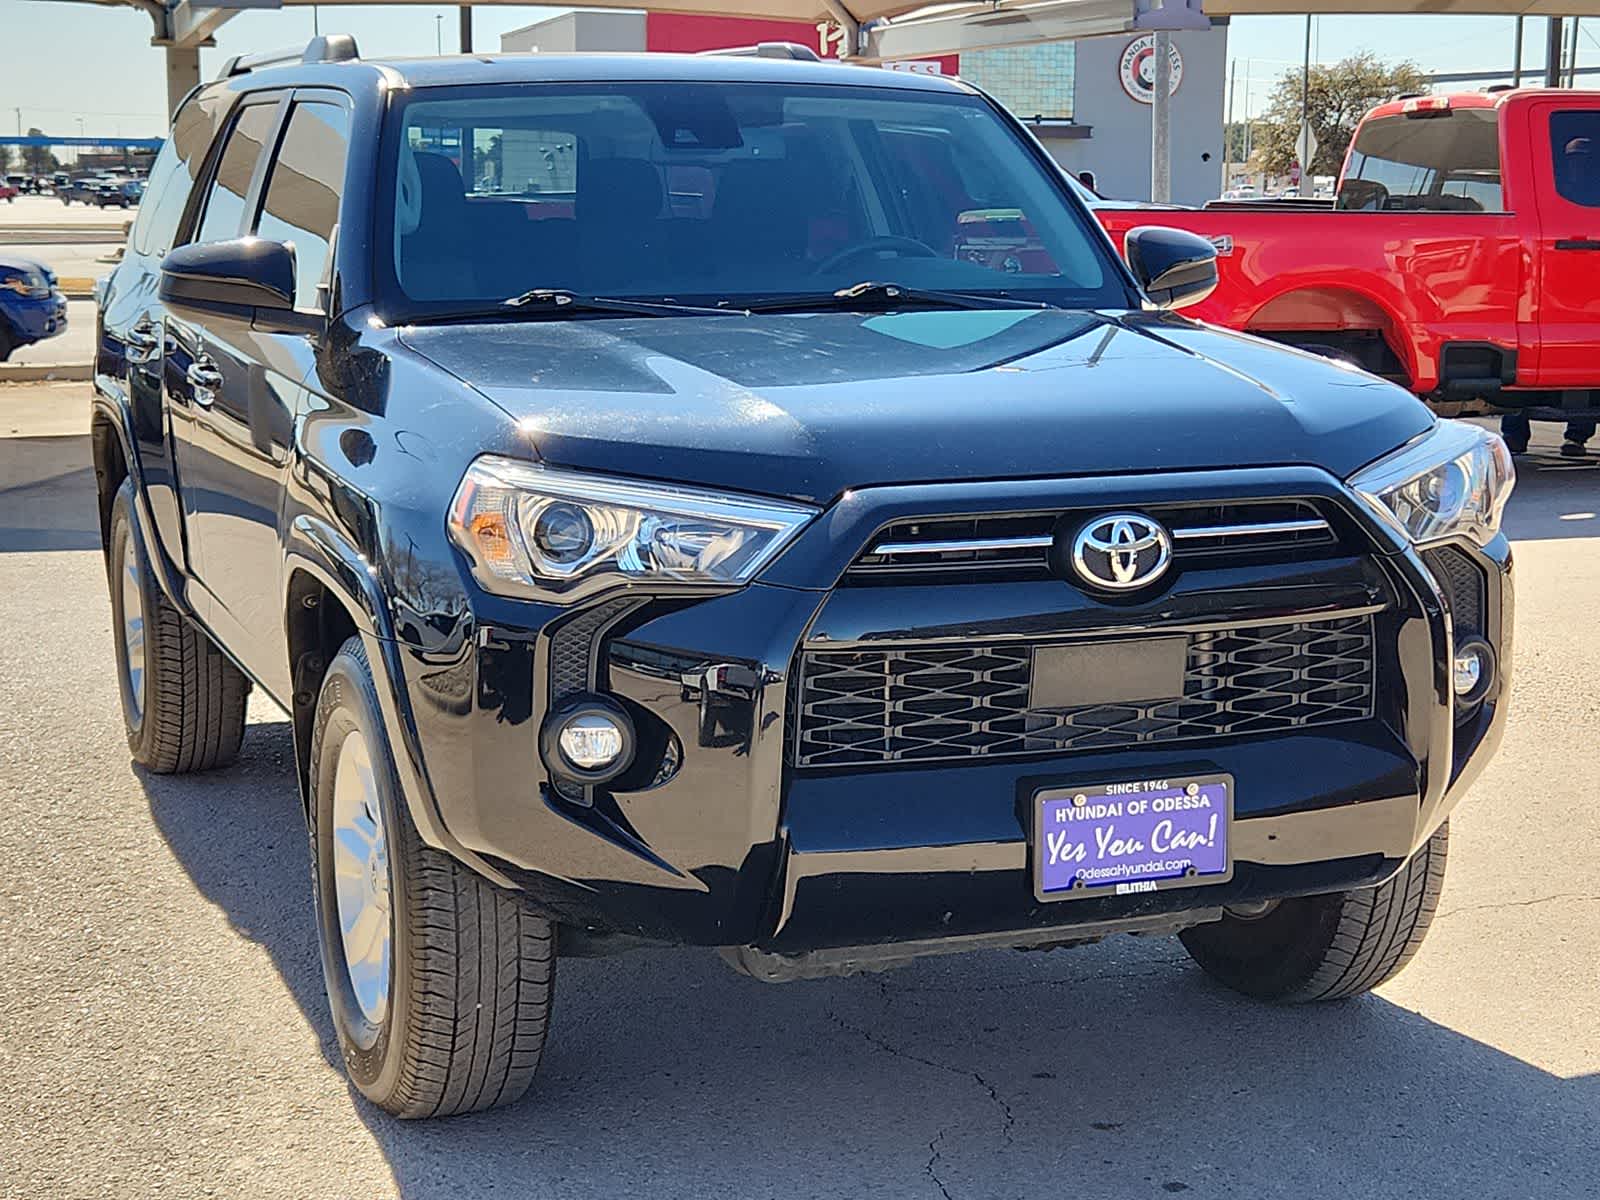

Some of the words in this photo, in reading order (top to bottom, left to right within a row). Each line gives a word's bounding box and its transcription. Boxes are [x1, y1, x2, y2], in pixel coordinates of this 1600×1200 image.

[1122, 40, 1147, 70] PANDA
[1106, 782, 1140, 796] SINCE
[1143, 780, 1169, 793] 1946
[1055, 802, 1123, 823] HYUNDAI
[1127, 800, 1149, 816] OF
[1152, 794, 1211, 813] ODESSA
[1047, 830, 1087, 865] Yes
[1095, 824, 1144, 859] You
[1151, 813, 1218, 854] Can!
[1075, 859, 1192, 880] OdessaHyundai.com
